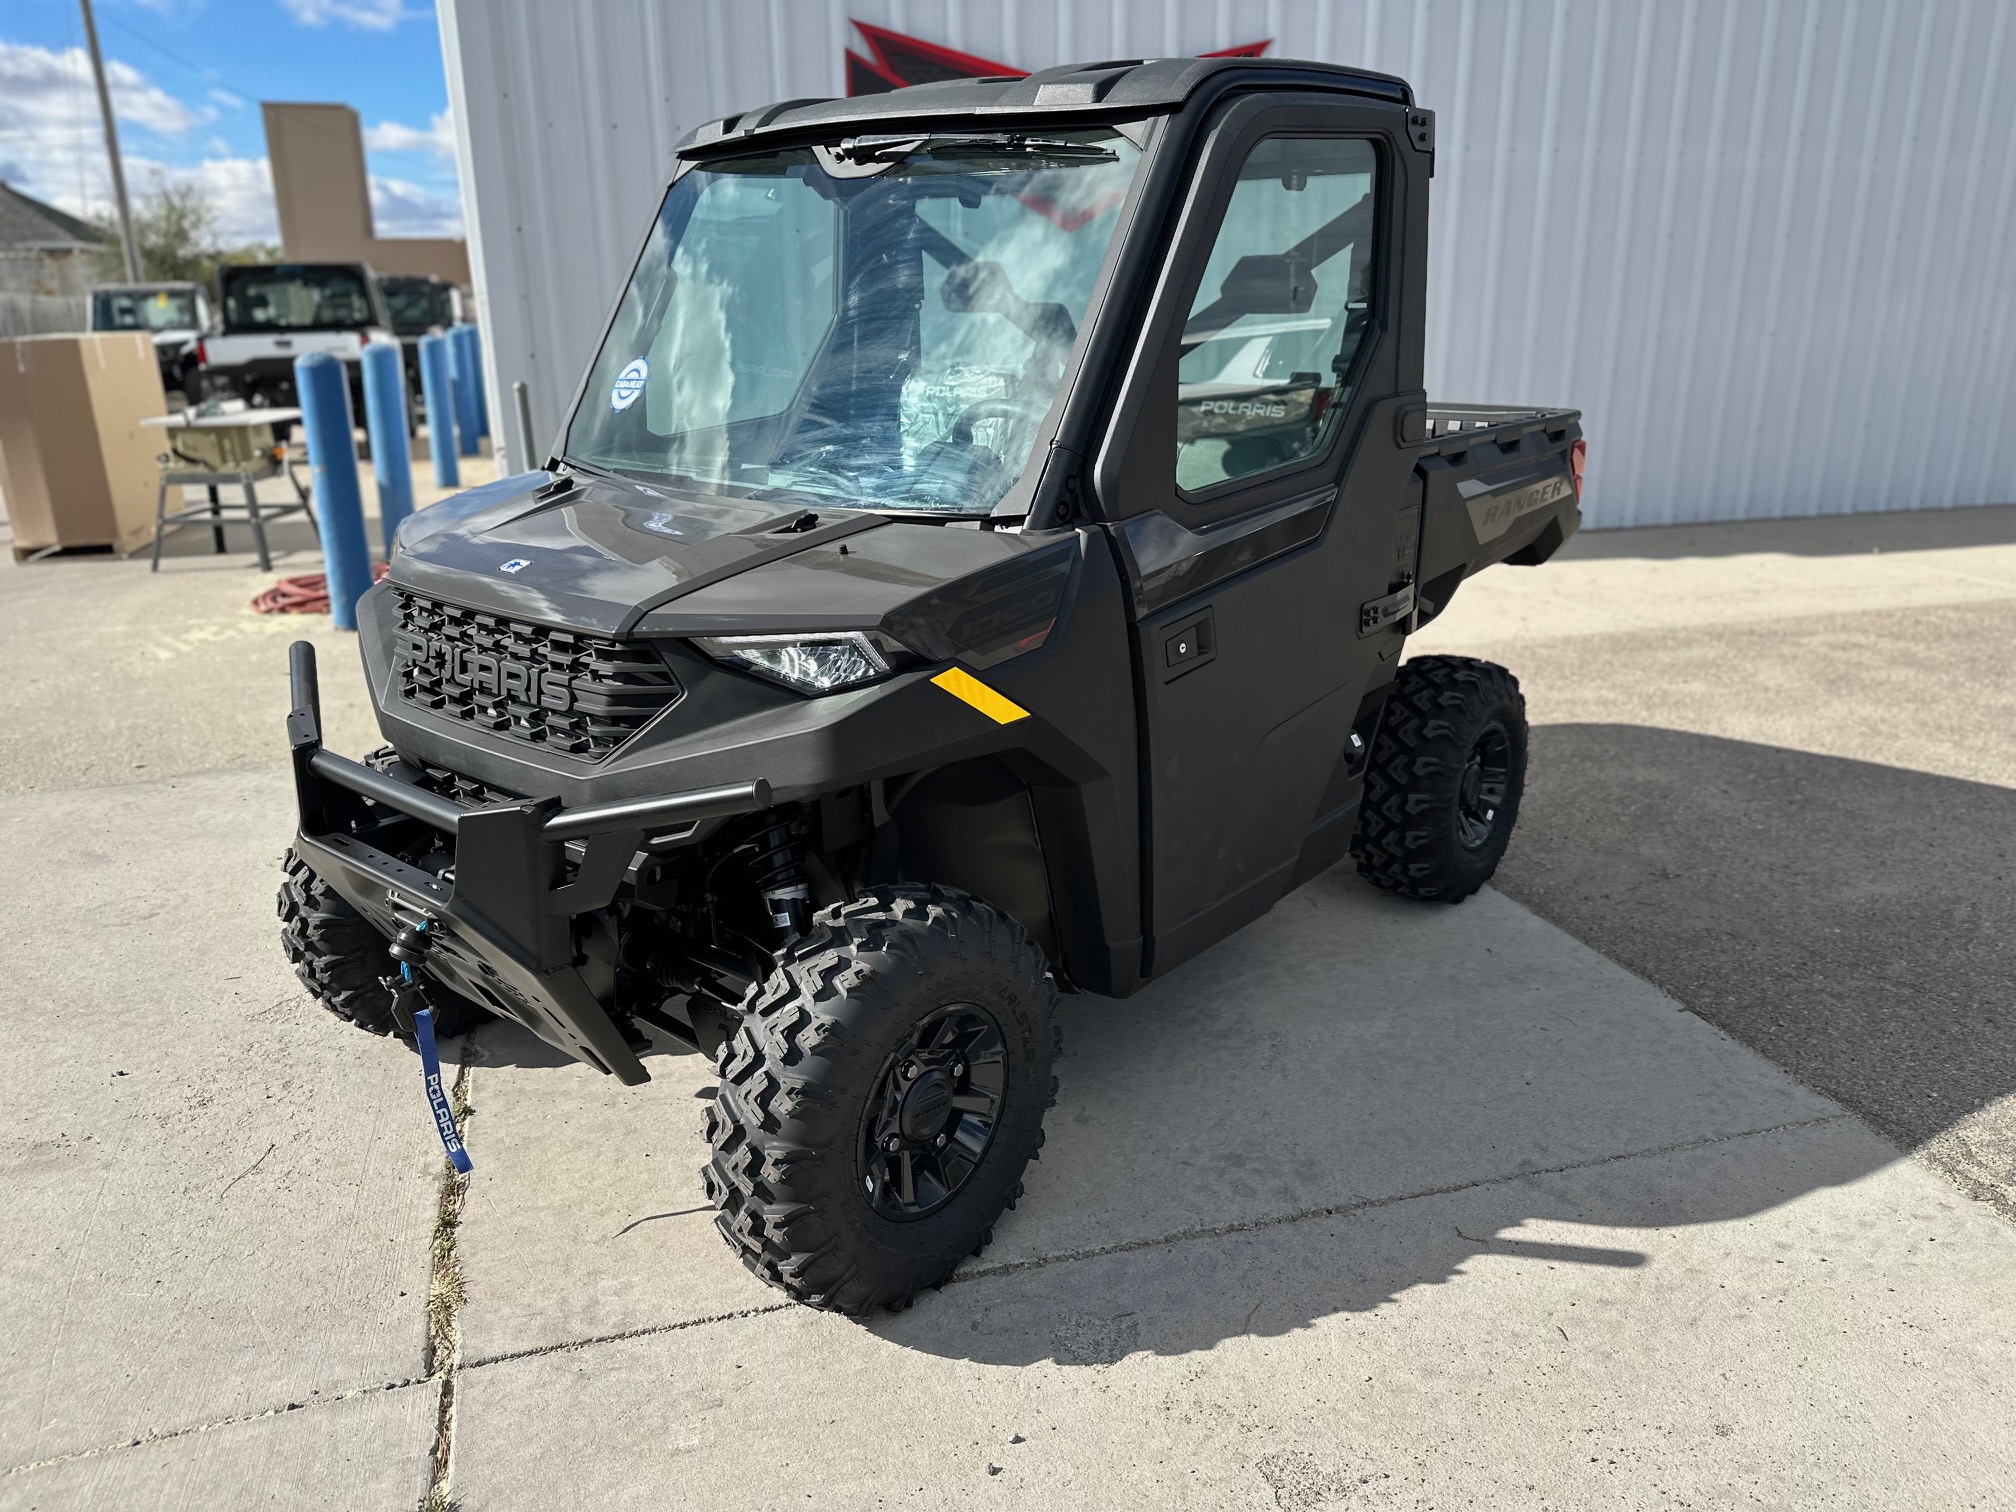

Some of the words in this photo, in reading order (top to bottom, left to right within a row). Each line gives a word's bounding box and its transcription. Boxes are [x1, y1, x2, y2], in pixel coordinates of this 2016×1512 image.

[1200, 401, 1286, 418] POLARIS
[1482, 480, 1564, 526] RANGER
[406, 631, 573, 712] POLARIS
[427, 1073, 461, 1153] POLARIS
